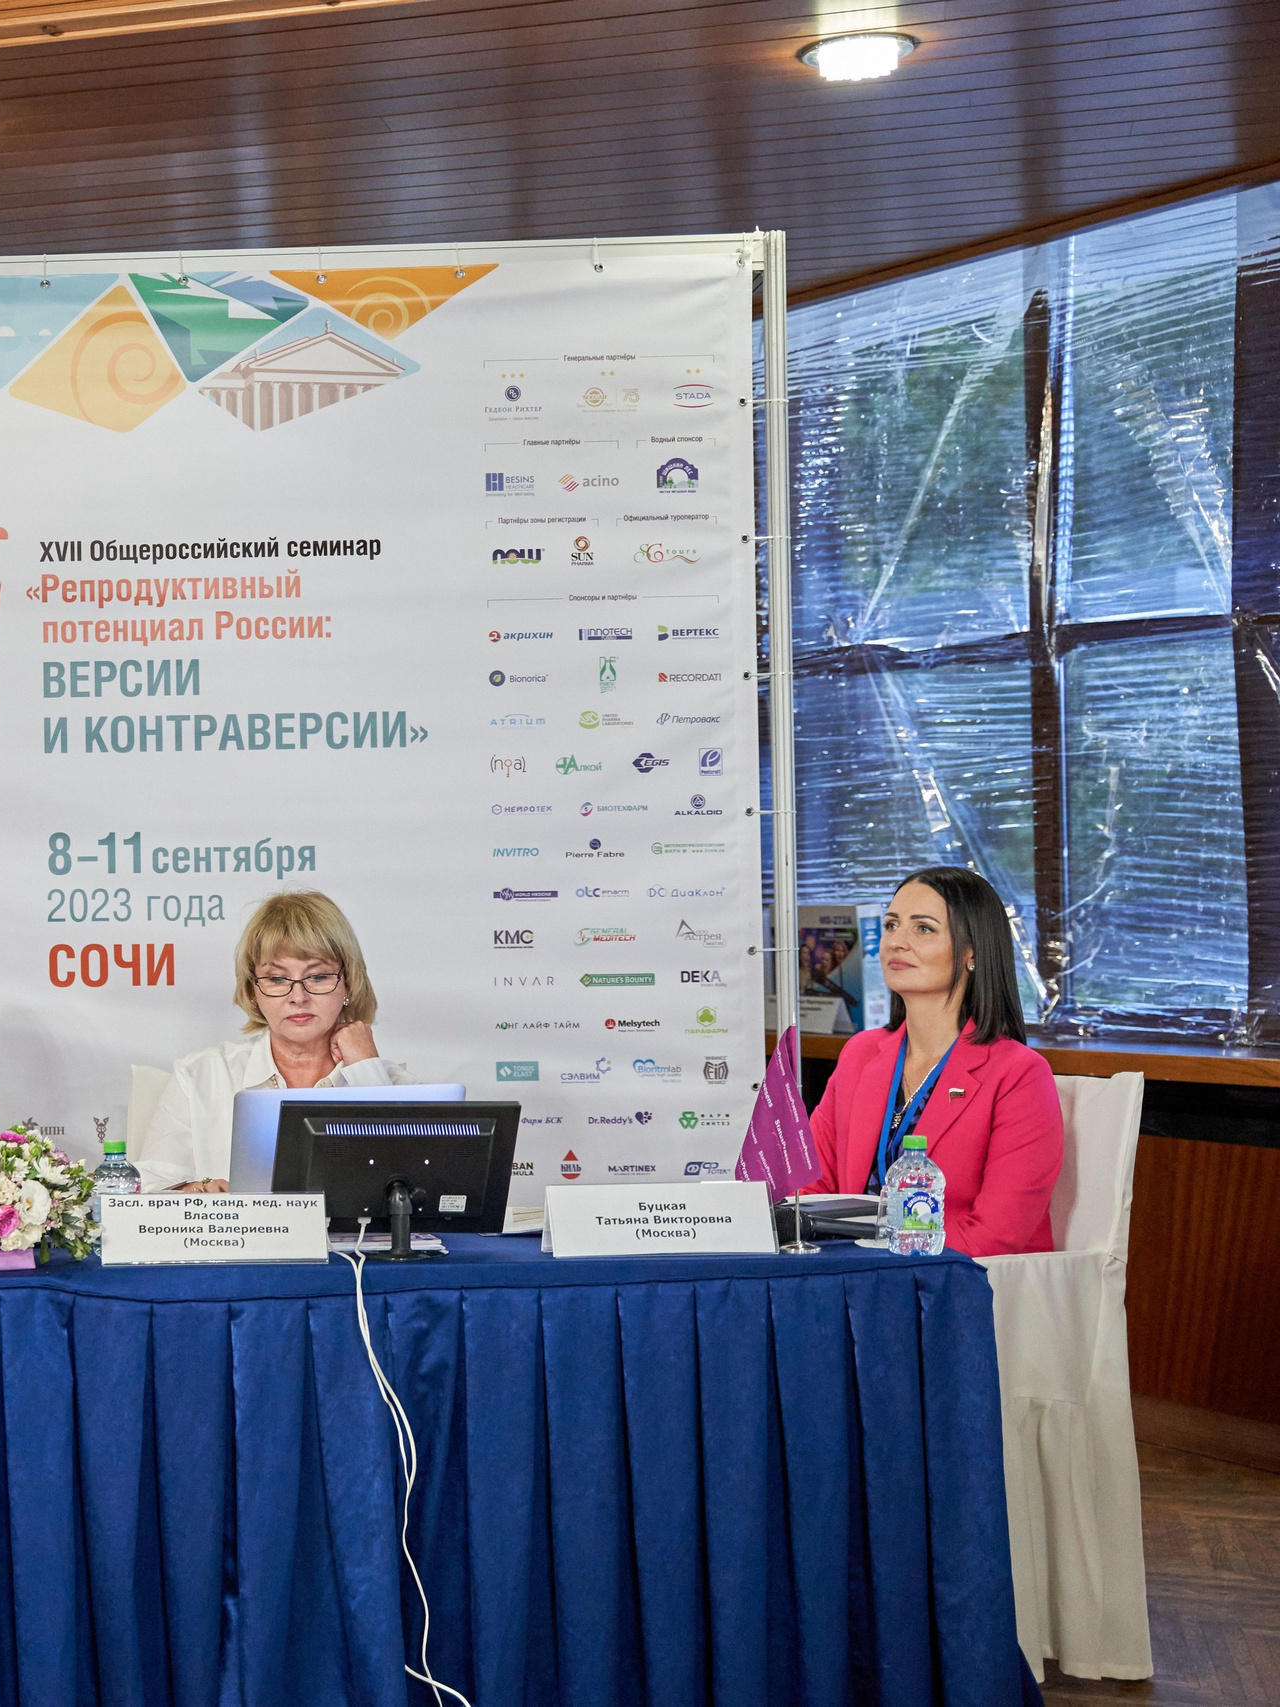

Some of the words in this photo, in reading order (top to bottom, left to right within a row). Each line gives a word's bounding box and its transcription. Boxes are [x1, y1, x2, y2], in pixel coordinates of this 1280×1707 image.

[564, 354, 605, 362] Генеральные
[606, 353, 636, 362] партнёры
[676, 392, 711, 400] STADA
[551, 438, 581, 446] партнёры
[505, 476, 535, 484] BESINS
[583, 475, 619, 487] acino
[498, 517, 528, 525] Партнёры
[547, 516, 586, 524] регистрации
[623, 513, 668, 523] Официальный
[670, 513, 709, 522] туроператор
[40, 541, 83, 563] XVII
[90, 537, 279, 565] Общероссийский
[286, 538, 381, 561] семинар
[571, 552, 594, 561] SUN
[26, 569, 302, 609] «Репродуктивный
[569, 594, 600, 602] Спонсоры
[608, 594, 637, 602] партнёры
[42, 617, 205, 647] потенциал
[215, 609, 332, 640] России:
[672, 628, 719, 637] ВЕРТЕКС
[504, 631, 553, 642] акрихин
[42, 658, 201, 699] ВЕРСИИ
[669, 673, 722, 682] RECORDATI
[672, 715, 721, 725] Петровакс
[43, 716, 69, 754] И
[84, 710, 429, 753] КОНТРАВЕРСИИ»
[644, 758, 670, 767] EGIS
[493, 848, 539, 858] INVITRO
[152, 837, 316, 880] сентября
[47, 887, 133, 923] 2023
[147, 893, 225, 927] года
[48, 943, 176, 988] СОЧИ
[494, 976, 555, 987] INVAR
[681, 970, 722, 983] DEKA
[618, 1019, 660, 1028] Melsytech
[561, 1073, 600, 1081] СЭЛВИМ
[40, 1126, 65, 1136] ИПН
[512, 1162, 534, 1170] BAN
[109, 1198, 143, 1208] Засл.
[148, 1200, 180, 1210] врач
[184, 1198, 207, 1209] РФ,
[212, 1200, 248, 1209] канд.
[253, 1200, 282, 1209] мед.
[287, 1200, 318, 1210] наук
[639, 1202, 687, 1213] Буцкая
[184, 1211, 239, 1220] Власова
[596, 1216, 649, 1226] Татьяна
[654, 1215, 732, 1225] Викторовна
[139, 1225, 204, 1235] Вероника
[208, 1225, 289, 1235] Валериевна
[635, 1228, 697, 1240] (Москва)
[183, 1238, 246, 1248] (Москва)
